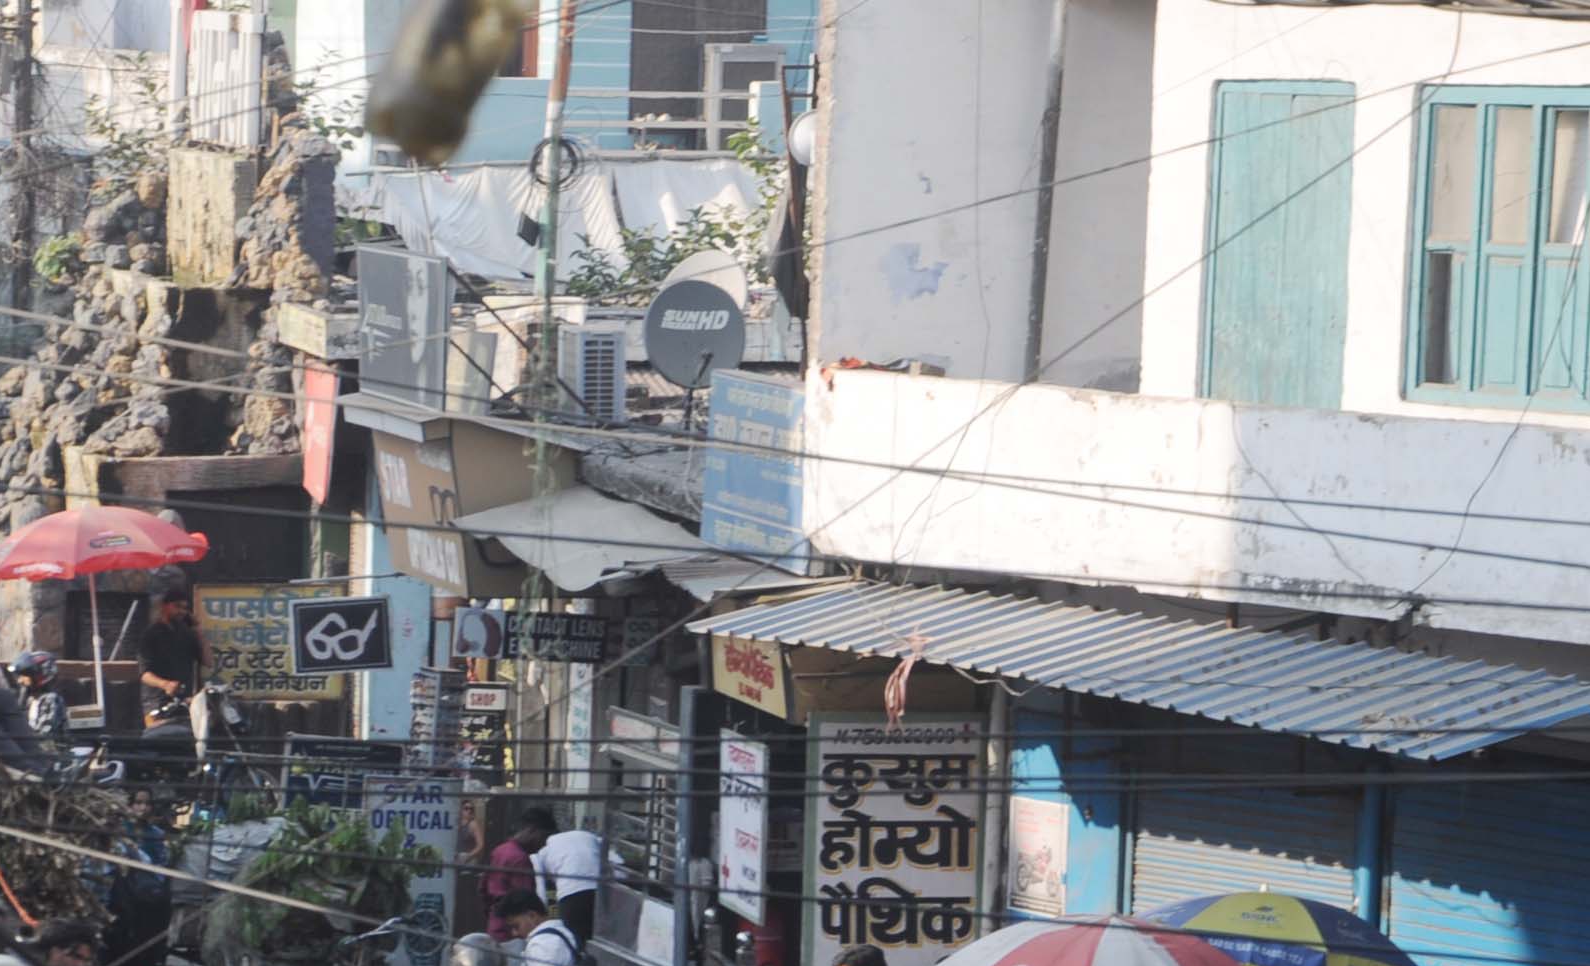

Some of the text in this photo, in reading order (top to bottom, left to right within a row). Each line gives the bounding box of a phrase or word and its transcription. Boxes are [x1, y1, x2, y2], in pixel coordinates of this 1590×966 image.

[384, 784, 444, 805] STAR
[822, 754, 978, 809] कुसुम
[819, 804, 978, 872] होम्यो
[816, 876, 972, 945] पैथिक
